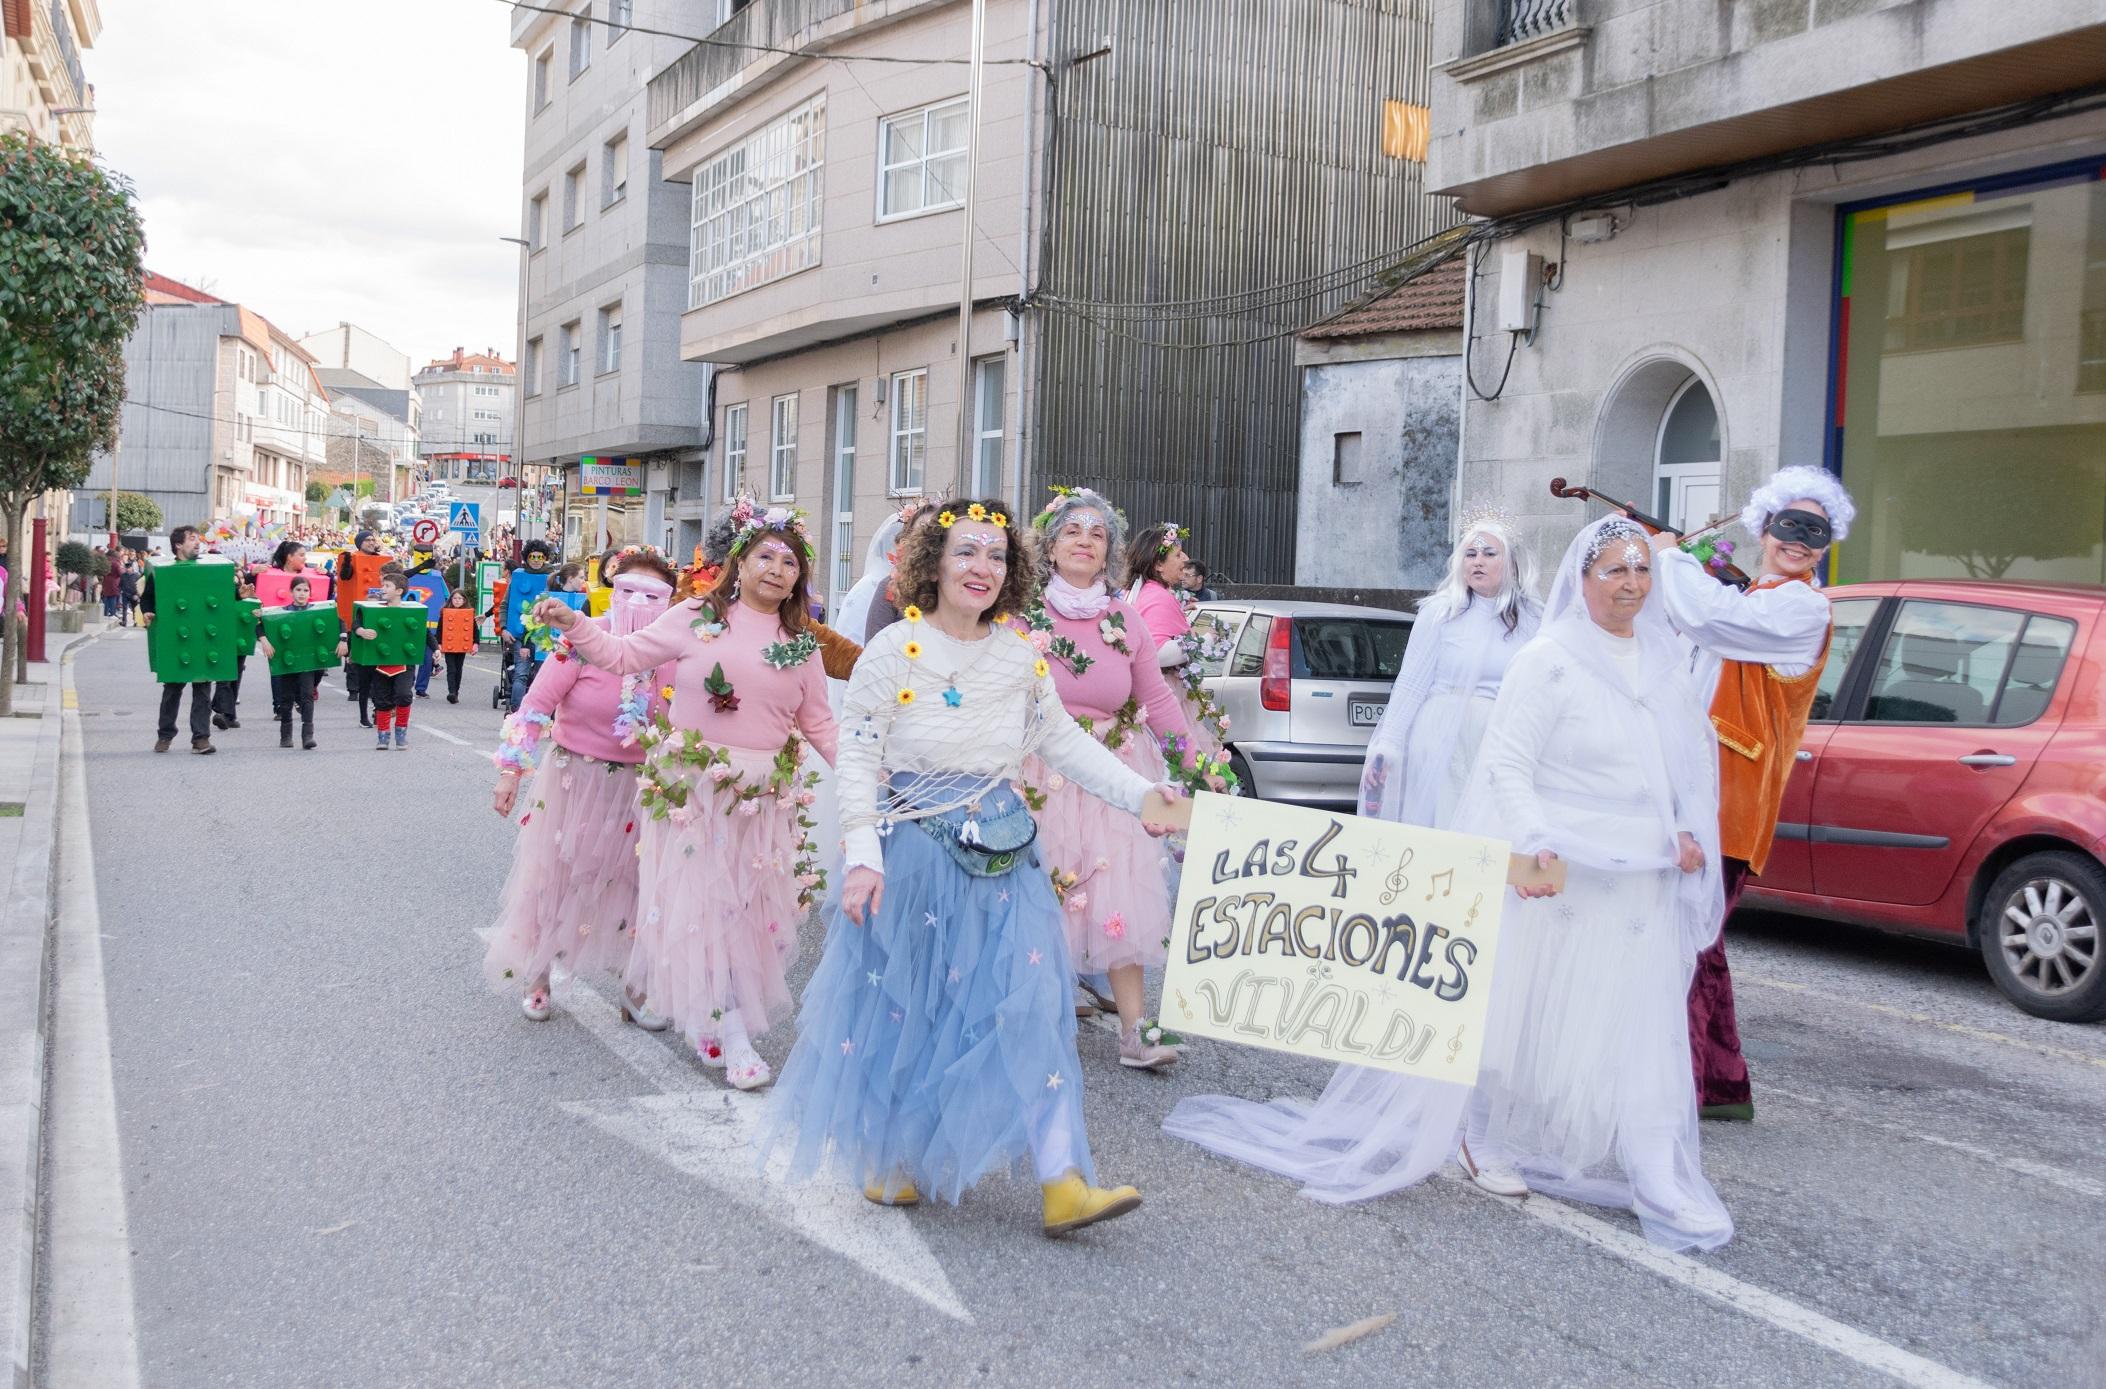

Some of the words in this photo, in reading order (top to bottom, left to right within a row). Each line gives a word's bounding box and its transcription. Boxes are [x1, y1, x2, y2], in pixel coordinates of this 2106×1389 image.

[583, 476, 611, 486] BARCO
[591, 466, 632, 477] PINTURAS
[1211, 838, 1298, 885] LAS
[1299, 818, 1357, 899] 4
[1187, 892, 1478, 1002] ESTACIONES
[1306, 959, 1333, 981] de
[1195, 969, 1437, 1066] VIVALDI
